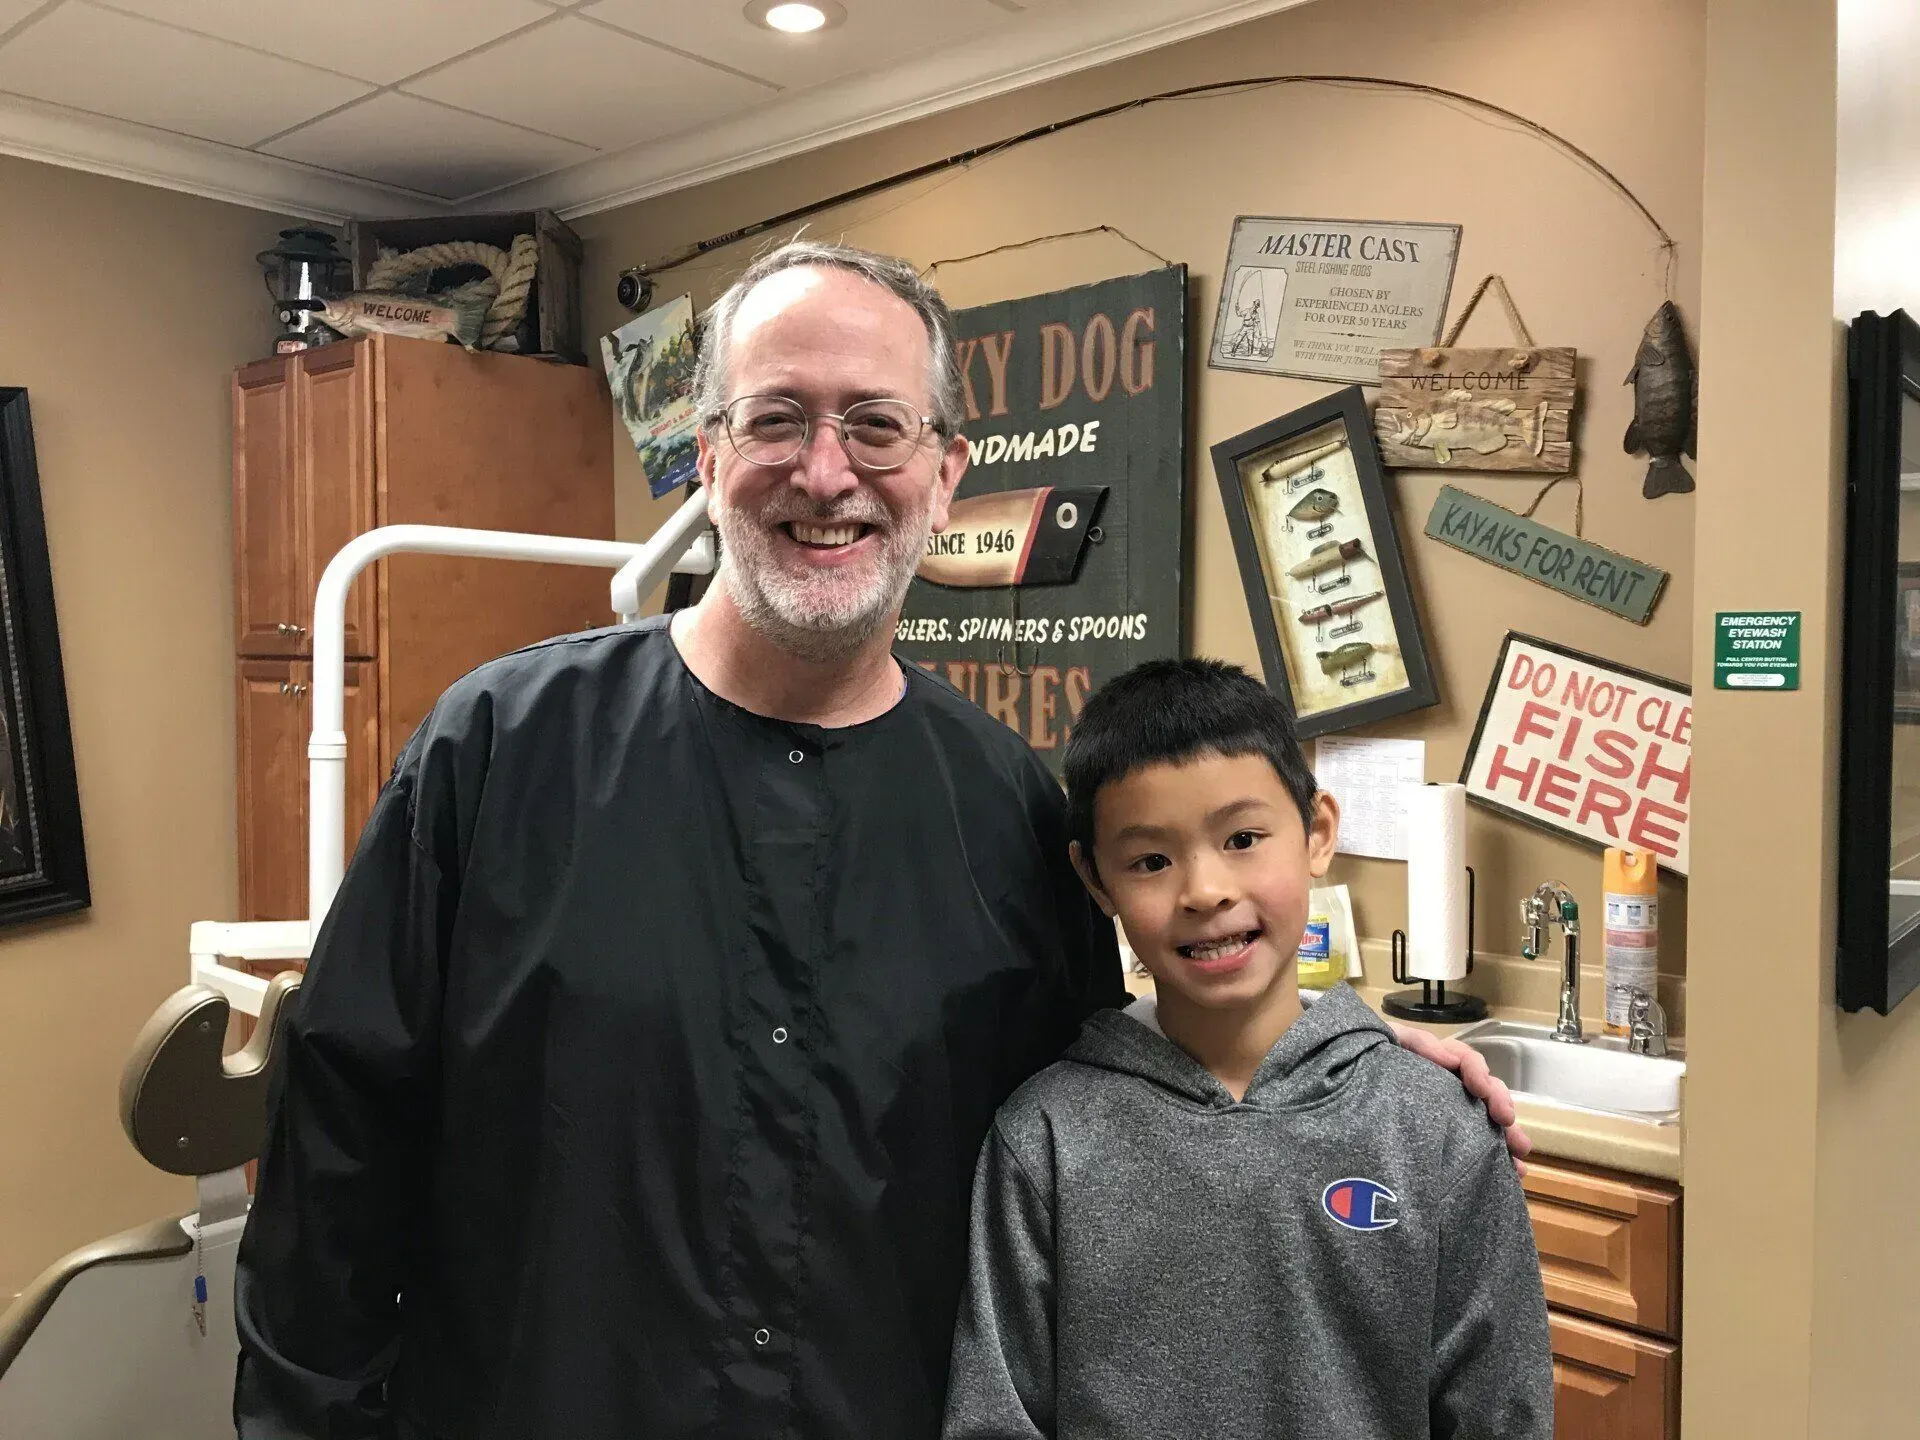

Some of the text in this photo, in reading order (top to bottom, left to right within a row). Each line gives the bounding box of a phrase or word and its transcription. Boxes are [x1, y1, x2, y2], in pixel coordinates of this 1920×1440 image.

[1257, 232, 1420, 263] MASTER CAST
[1295, 261, 1372, 277] STEEL FISHING RODS
[1330, 287, 1391, 300] CHOSEN BY
[363, 302, 432, 323] WELCOME
[1295, 298, 1424, 317] EXPERIENCED ANGLERS
[1304, 312, 1407, 330] FOR OVER 50 YEARS
[1293, 340, 1306, 348] WE
[1307, 341, 1333, 351] THINK
[1039, 306, 1156, 412] DOG
[1295, 351, 1316, 360] WITH
[1317, 352, 1344, 363] THEIR
[1411, 371, 1531, 391] WELCOME
[968, 420, 1100, 467] NDMADE
[927, 529, 1015, 557] SINCE 1946
[1439, 502, 1646, 606] KAYAKS FOR RENT
[895, 613, 1148, 643] GLERS, SPINNERS & SPOONS
[1721, 616, 1796, 626] EMERGENCY
[1728, 628, 1787, 637] EYEWASH
[1732, 640, 1782, 649] STATION
[1507, 653, 1692, 746] DO NOT CLE
[1512, 700, 1691, 805] FISH
[1485, 744, 1689, 858] HERE
